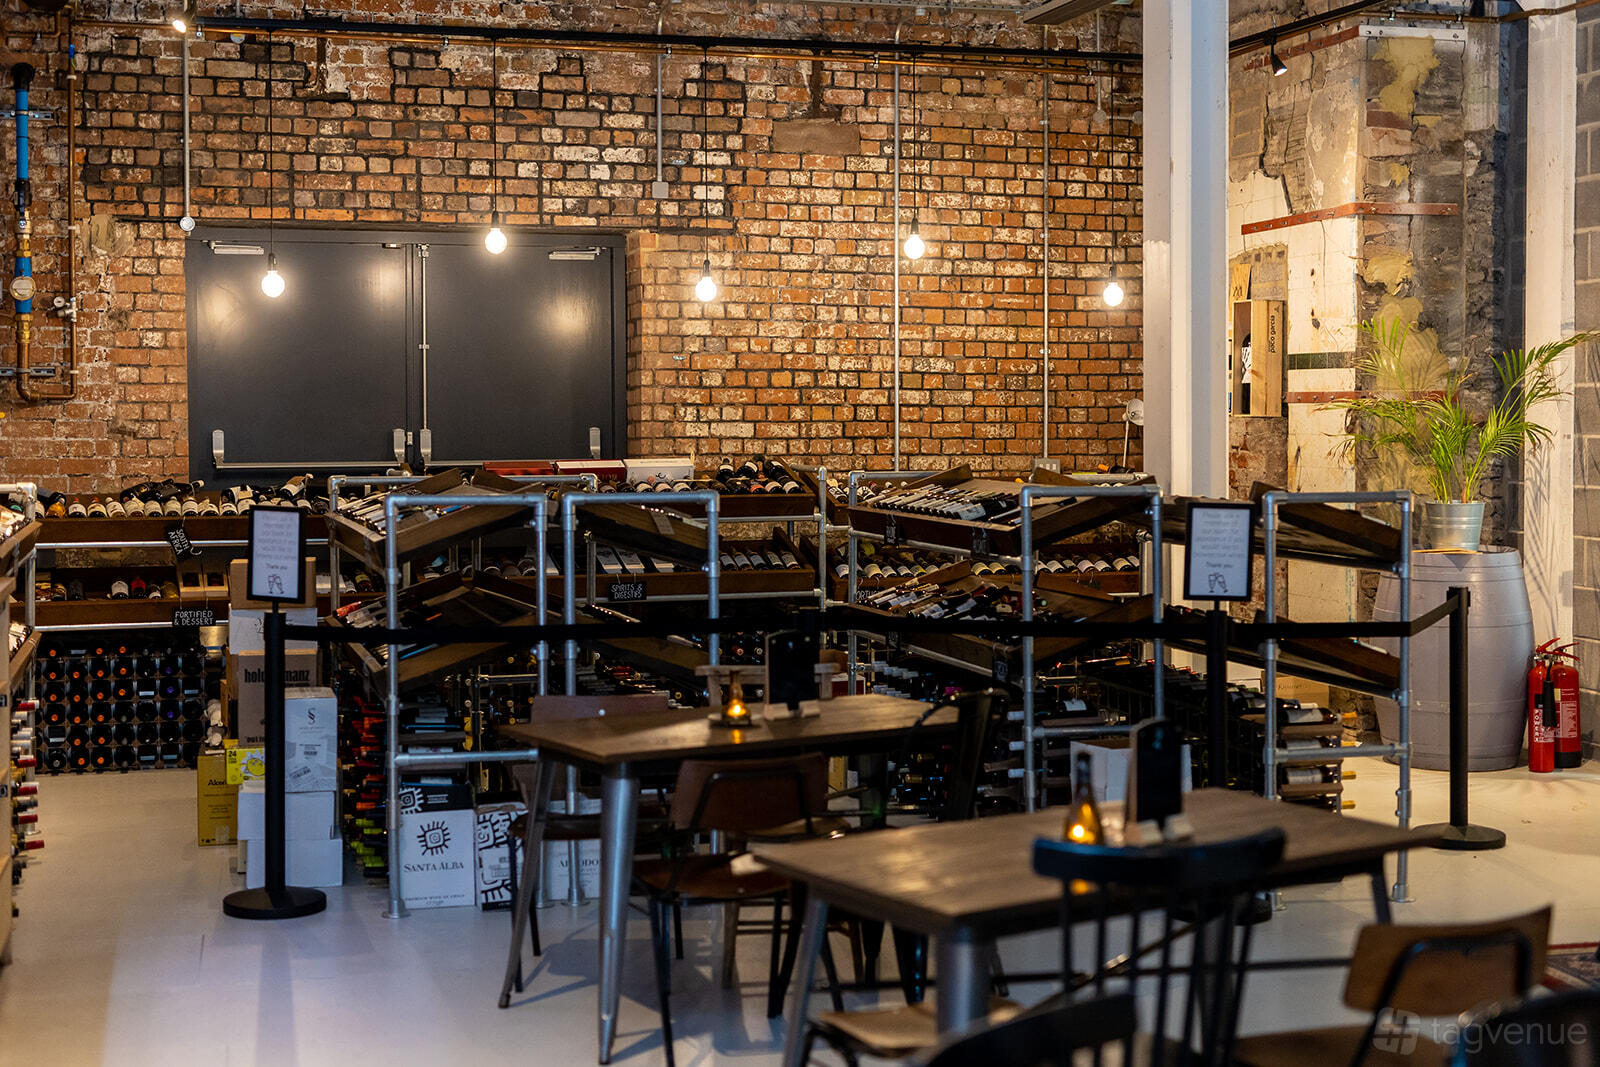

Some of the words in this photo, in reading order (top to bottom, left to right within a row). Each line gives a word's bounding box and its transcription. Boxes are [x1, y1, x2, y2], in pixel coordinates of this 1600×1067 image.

[168, 531, 183, 555] AFRICA
[176, 528, 190, 550] SOUTH
[611, 583, 635, 593] SPIRITS
[175, 610, 213, 618] FORTIFIED
[174, 618, 179, 626] &
[181, 617, 214, 626] DESSERT
[228, 750, 237, 758] 24
[403, 863, 437, 873] SANTA
[440, 861, 465, 871] ALBA
